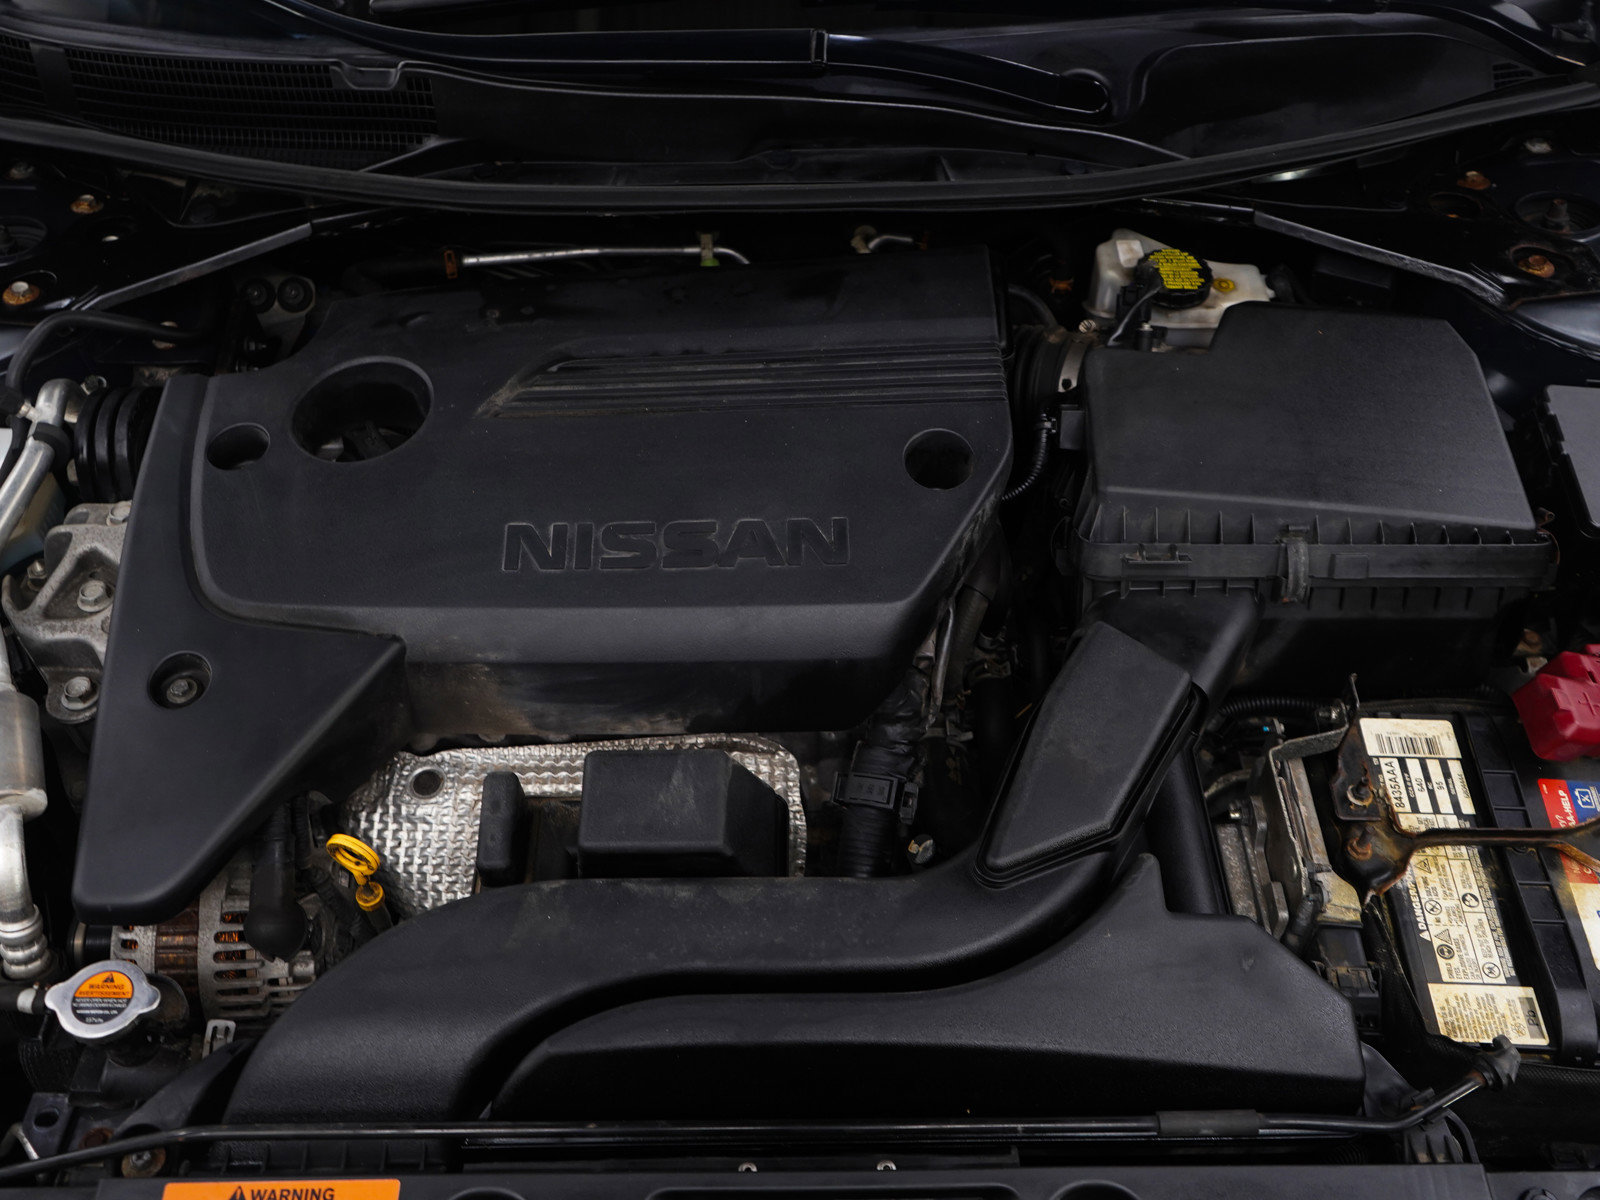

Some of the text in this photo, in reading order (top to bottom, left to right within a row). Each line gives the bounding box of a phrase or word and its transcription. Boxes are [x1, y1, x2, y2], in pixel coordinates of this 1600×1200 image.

[502, 517, 849, 571] NISSAN
[1385, 761, 1405, 808] 8435AAA
[1415, 778, 1425, 792] 640
[1436, 781, 1445, 791] 95
[1558, 789, 1576, 828] AA-HELP
[1527, 1010, 1539, 1026] Pb
[250, 1188, 335, 1200] WARNING
